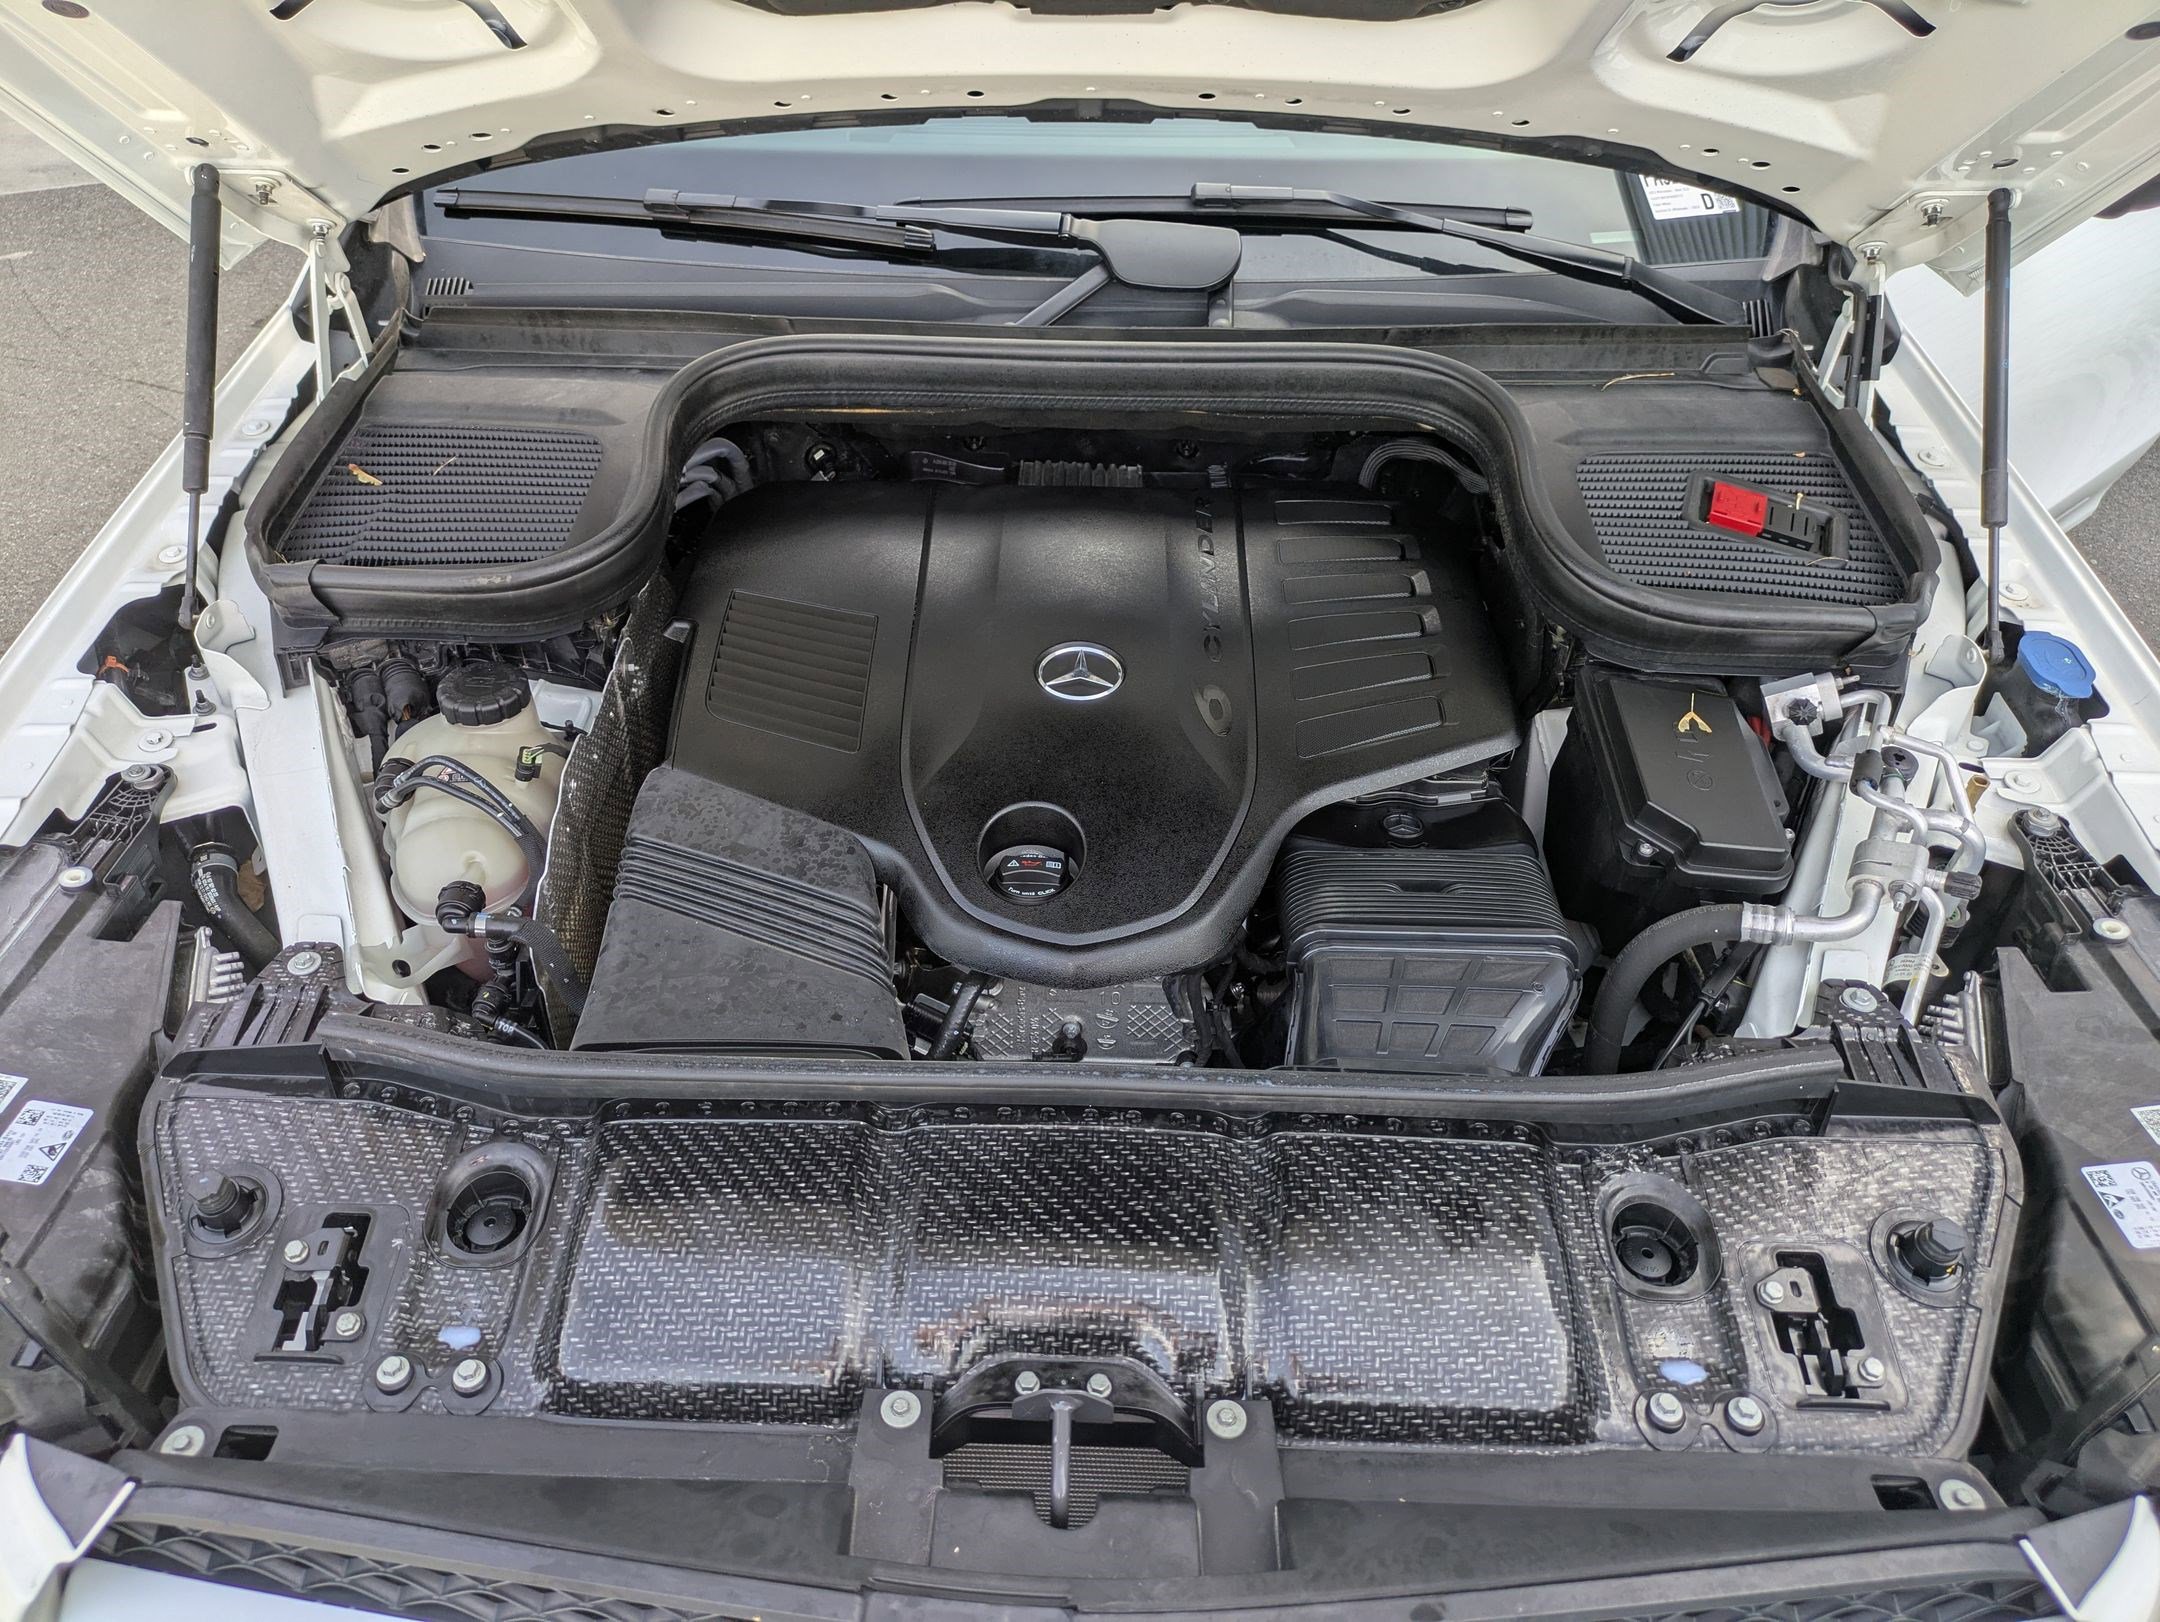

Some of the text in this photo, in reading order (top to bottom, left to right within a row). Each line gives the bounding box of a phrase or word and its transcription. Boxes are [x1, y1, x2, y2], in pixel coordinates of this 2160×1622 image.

[1700, 193, 1715, 210] D
[1195, 498, 1223, 664] CYLINDER
[1191, 684, 1233, 738] 6
[498, 1021, 515, 1034] TOP
